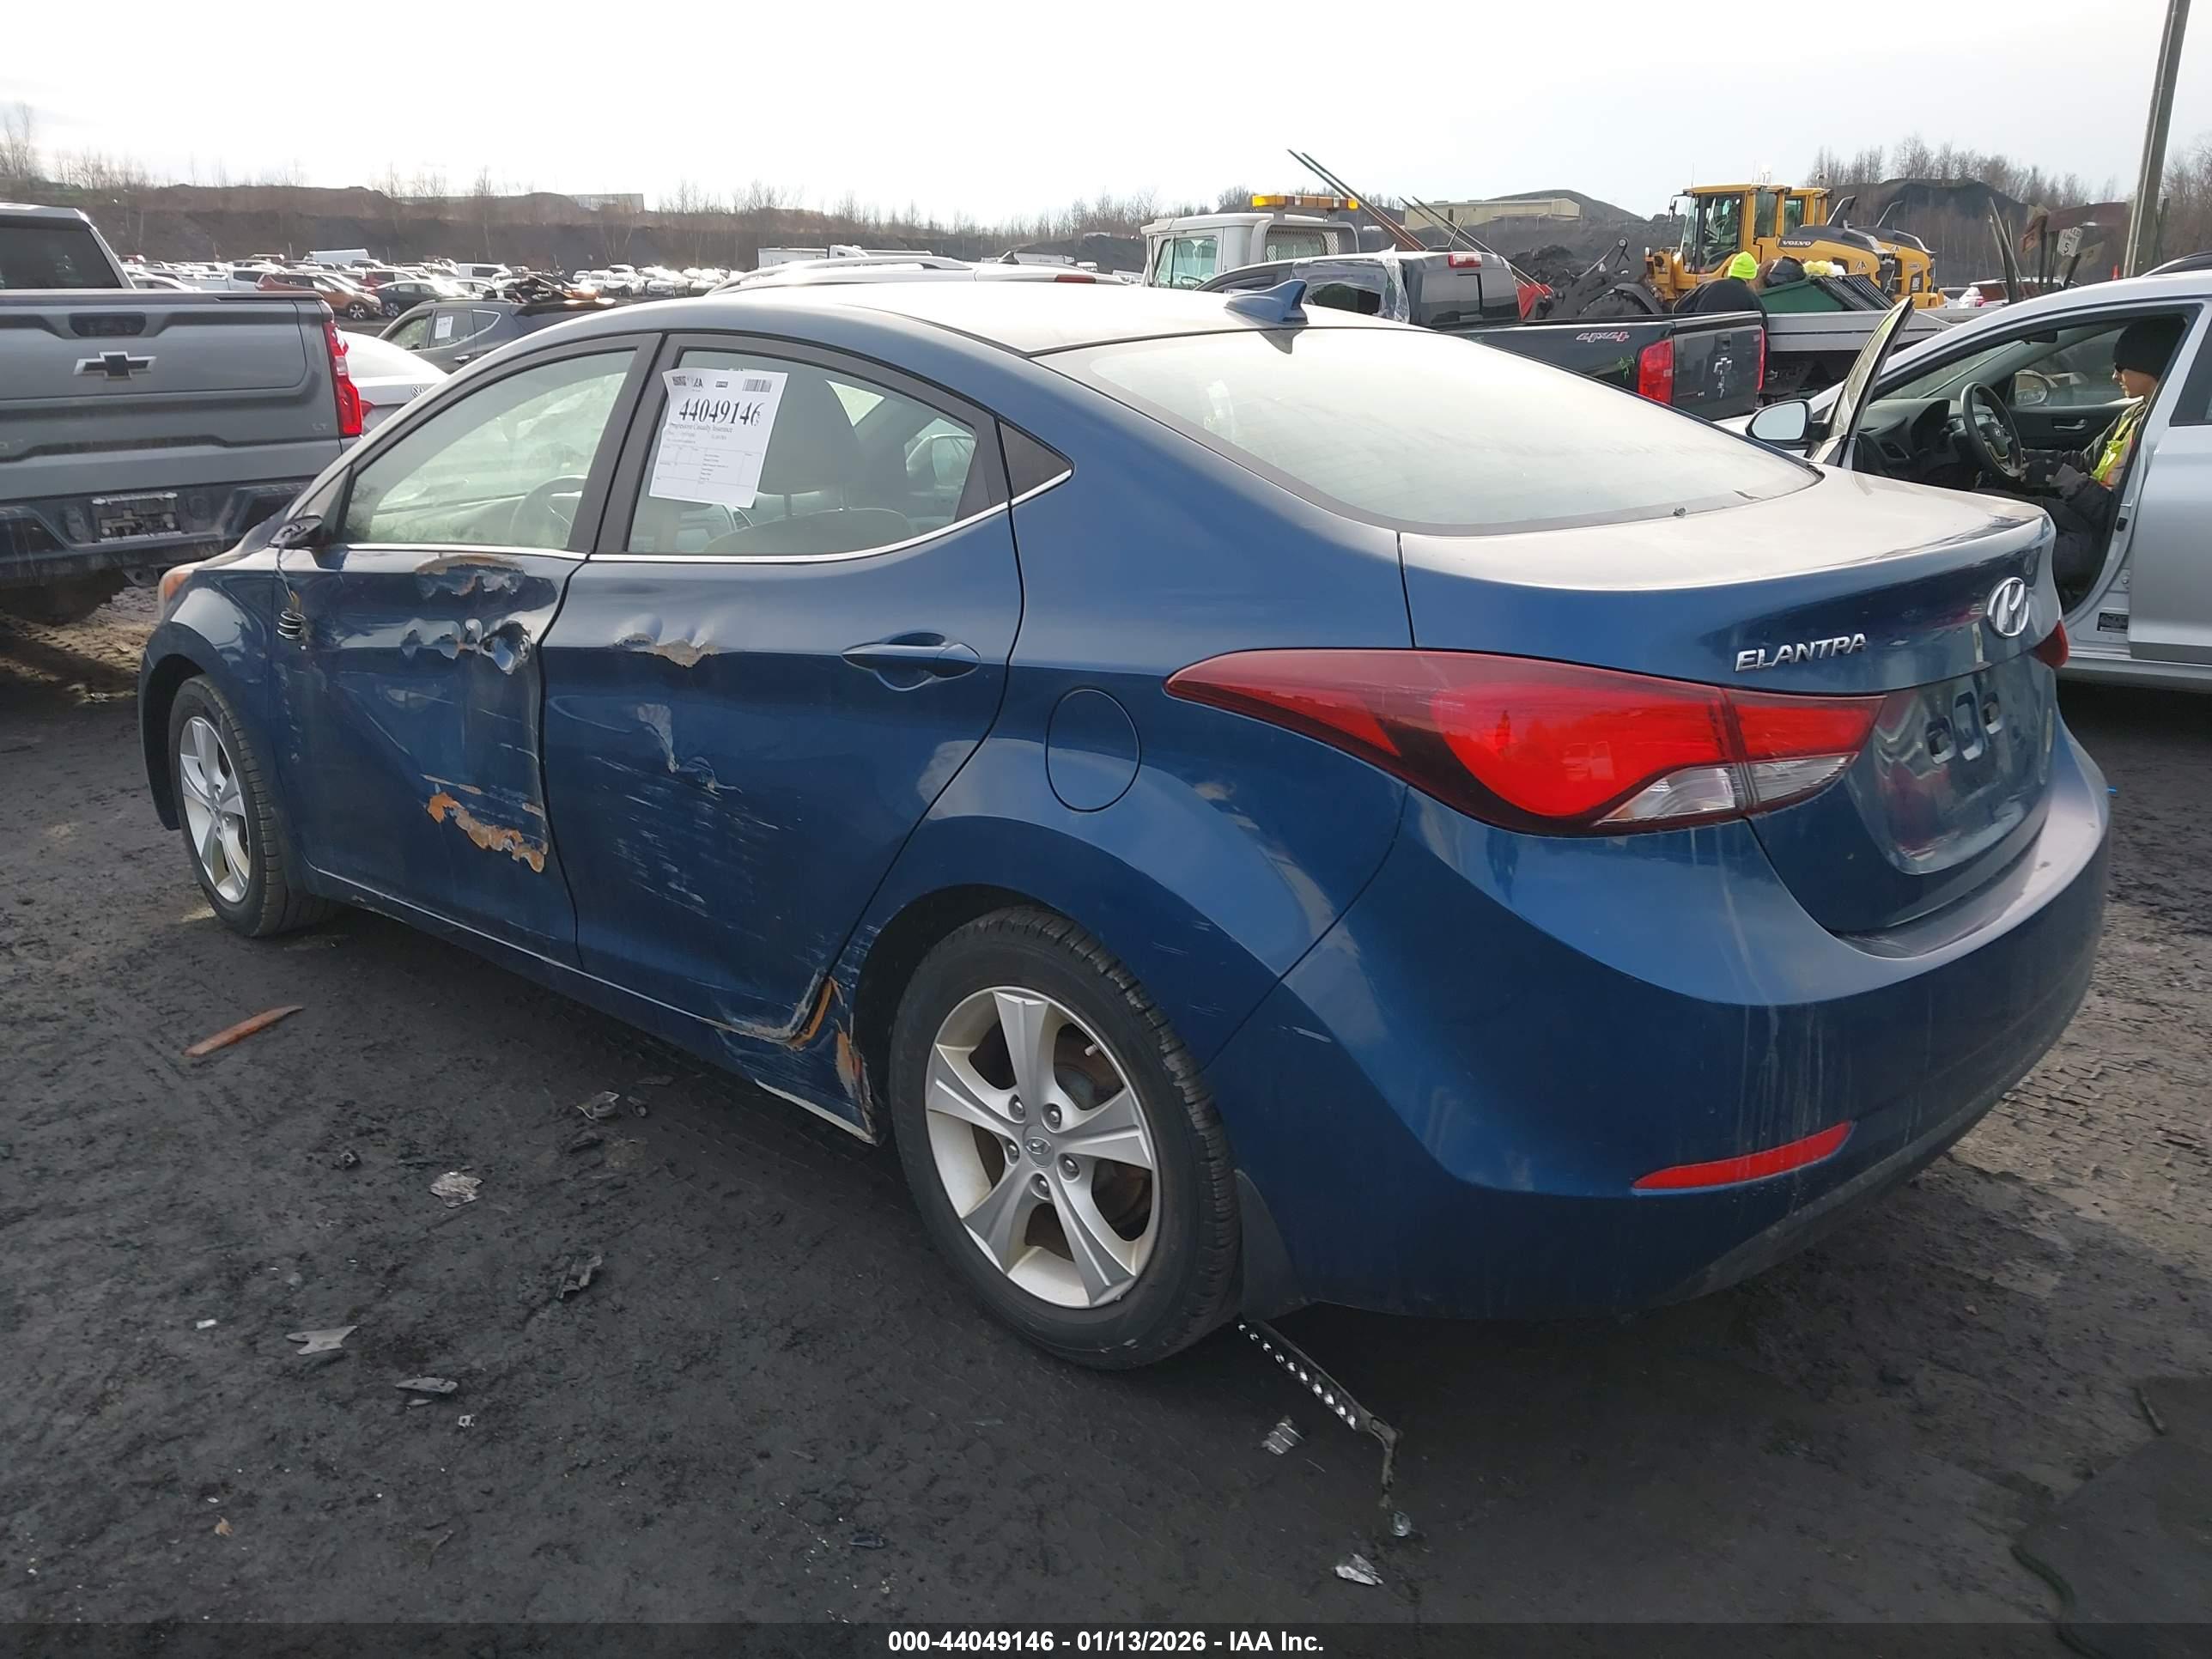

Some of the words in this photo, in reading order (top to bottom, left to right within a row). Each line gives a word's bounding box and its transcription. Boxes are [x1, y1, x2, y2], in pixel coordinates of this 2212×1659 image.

[2064, 242, 2069, 253] 5
[679, 398, 764, 427] 44049146
[1735, 633, 1867, 672] ELANTRA
